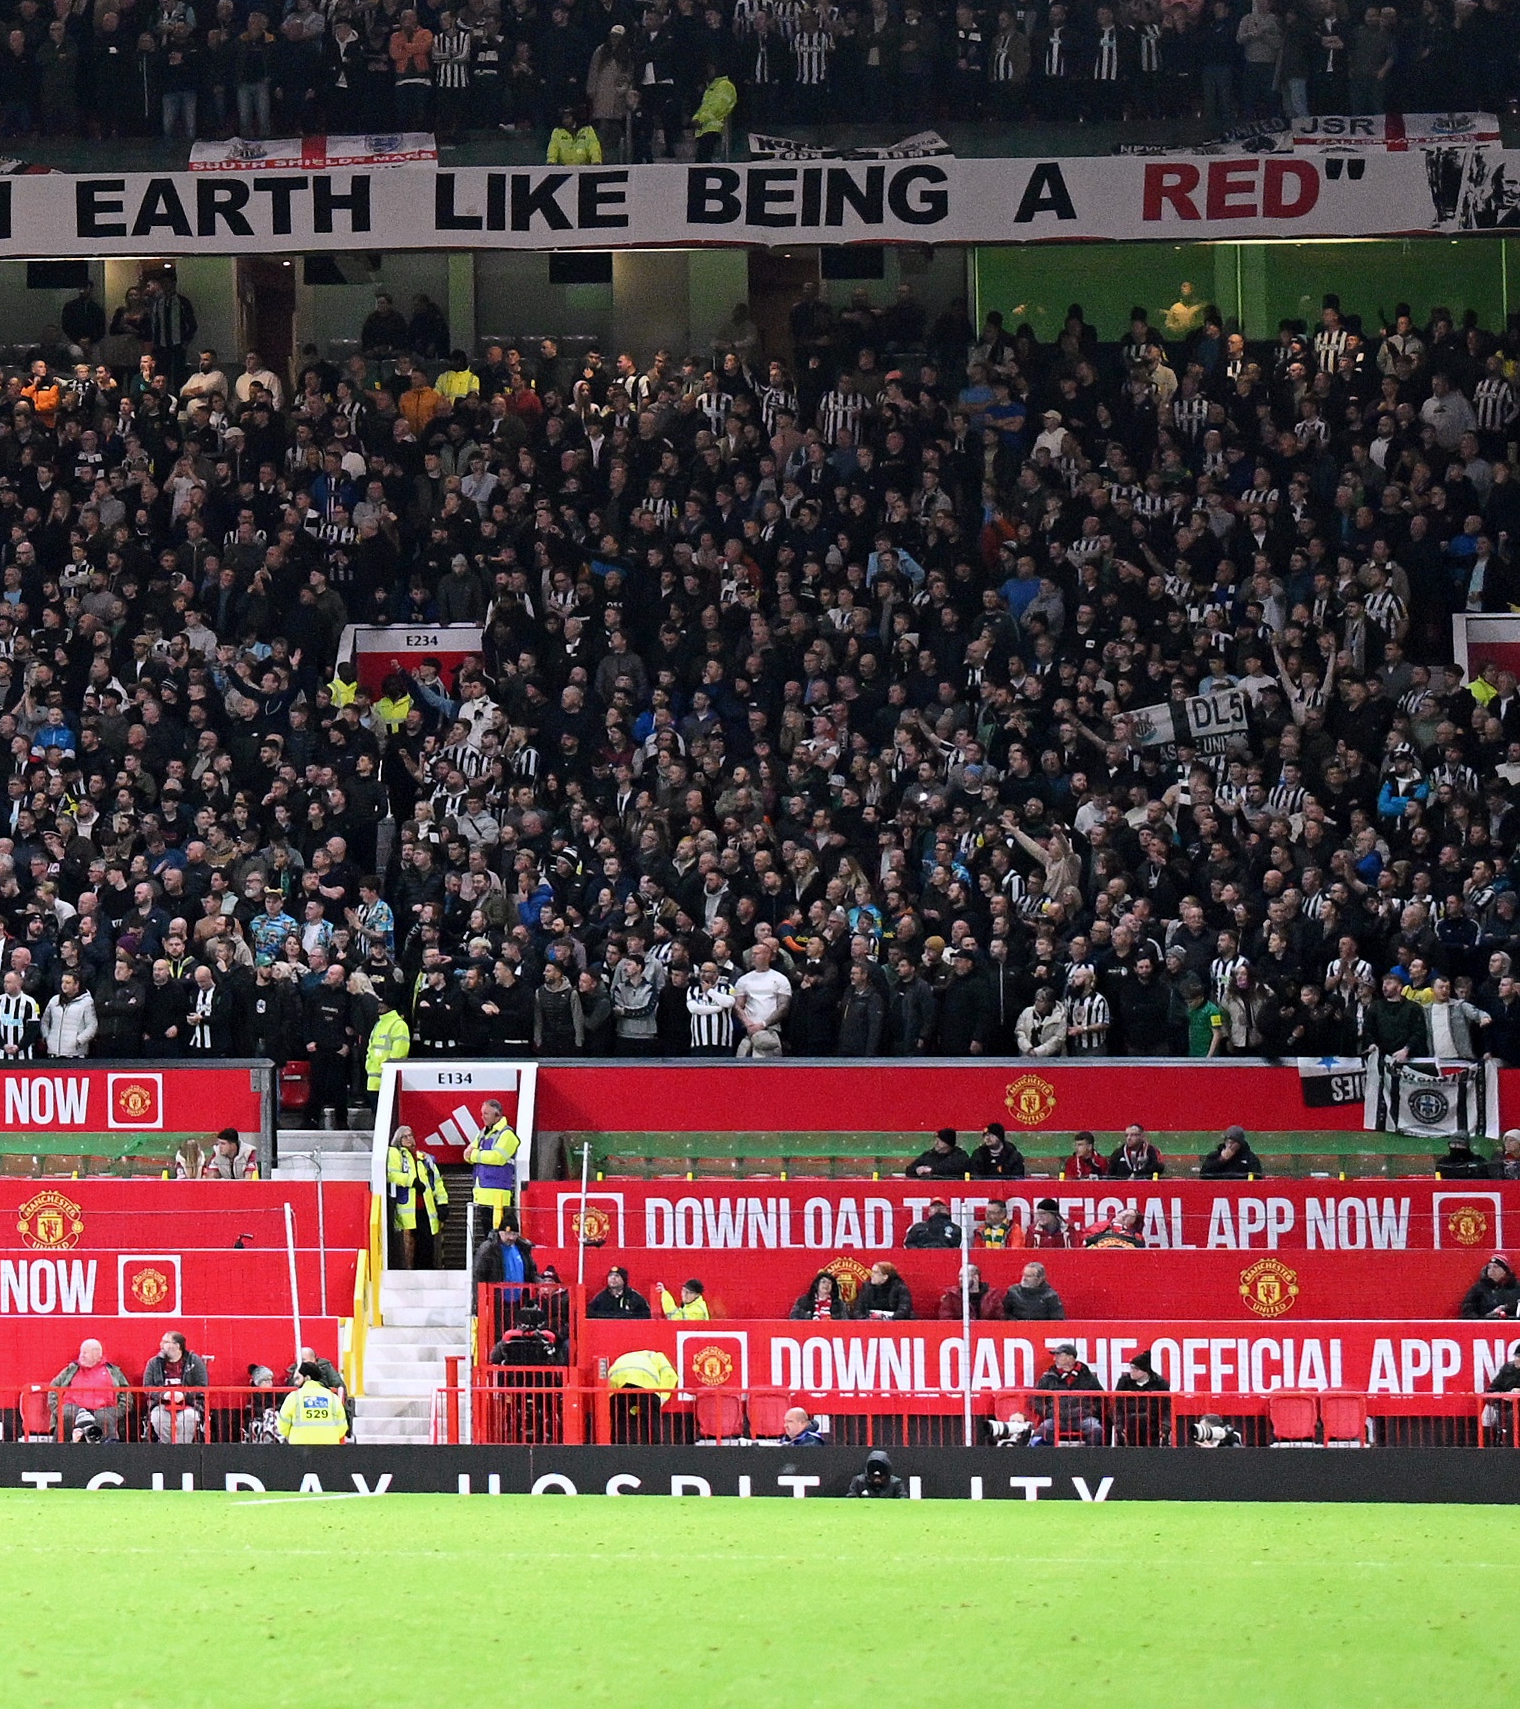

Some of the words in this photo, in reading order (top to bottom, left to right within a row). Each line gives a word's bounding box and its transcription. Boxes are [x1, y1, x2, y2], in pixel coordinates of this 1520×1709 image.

[1300, 117, 1375, 135] JSR
[192, 160, 266, 170] SOUTH
[373, 152, 434, 163] MAGS
[76, 173, 371, 238] EARTH
[435, 170, 630, 232] LIKE
[687, 164, 949, 228] BEING
[1014, 162, 1077, 223] A
[1142, 156, 1366, 221] RED"
[406, 635, 438, 646] E234
[1192, 692, 1244, 728] DL5
[438, 1073, 472, 1084] E134
[1009, 1077, 1051, 1094] MANCHESTER
[5, 1077, 90, 1124] NOW
[1016, 1112, 1046, 1122] UNITED
[24, 1192, 77, 1217] MANCHESTER
[645, 1197, 893, 1249] DOWNLOAD
[1207, 1197, 1295, 1249] APP
[1306, 1197, 1411, 1249] NOW
[824, 1259, 871, 1281] ANCHESTER
[1244, 1262, 1293, 1283] MANCHESTER
[0, 1259, 97, 1314] NOW
[1252, 1303, 1287, 1314] UNITED
[770, 1337, 1034, 1391] DOWNLOAD
[1149, 1337, 1350, 1391] OFFICIAL
[1368, 1337, 1462, 1391] APP
[306, 1409, 328, 1419] 529
